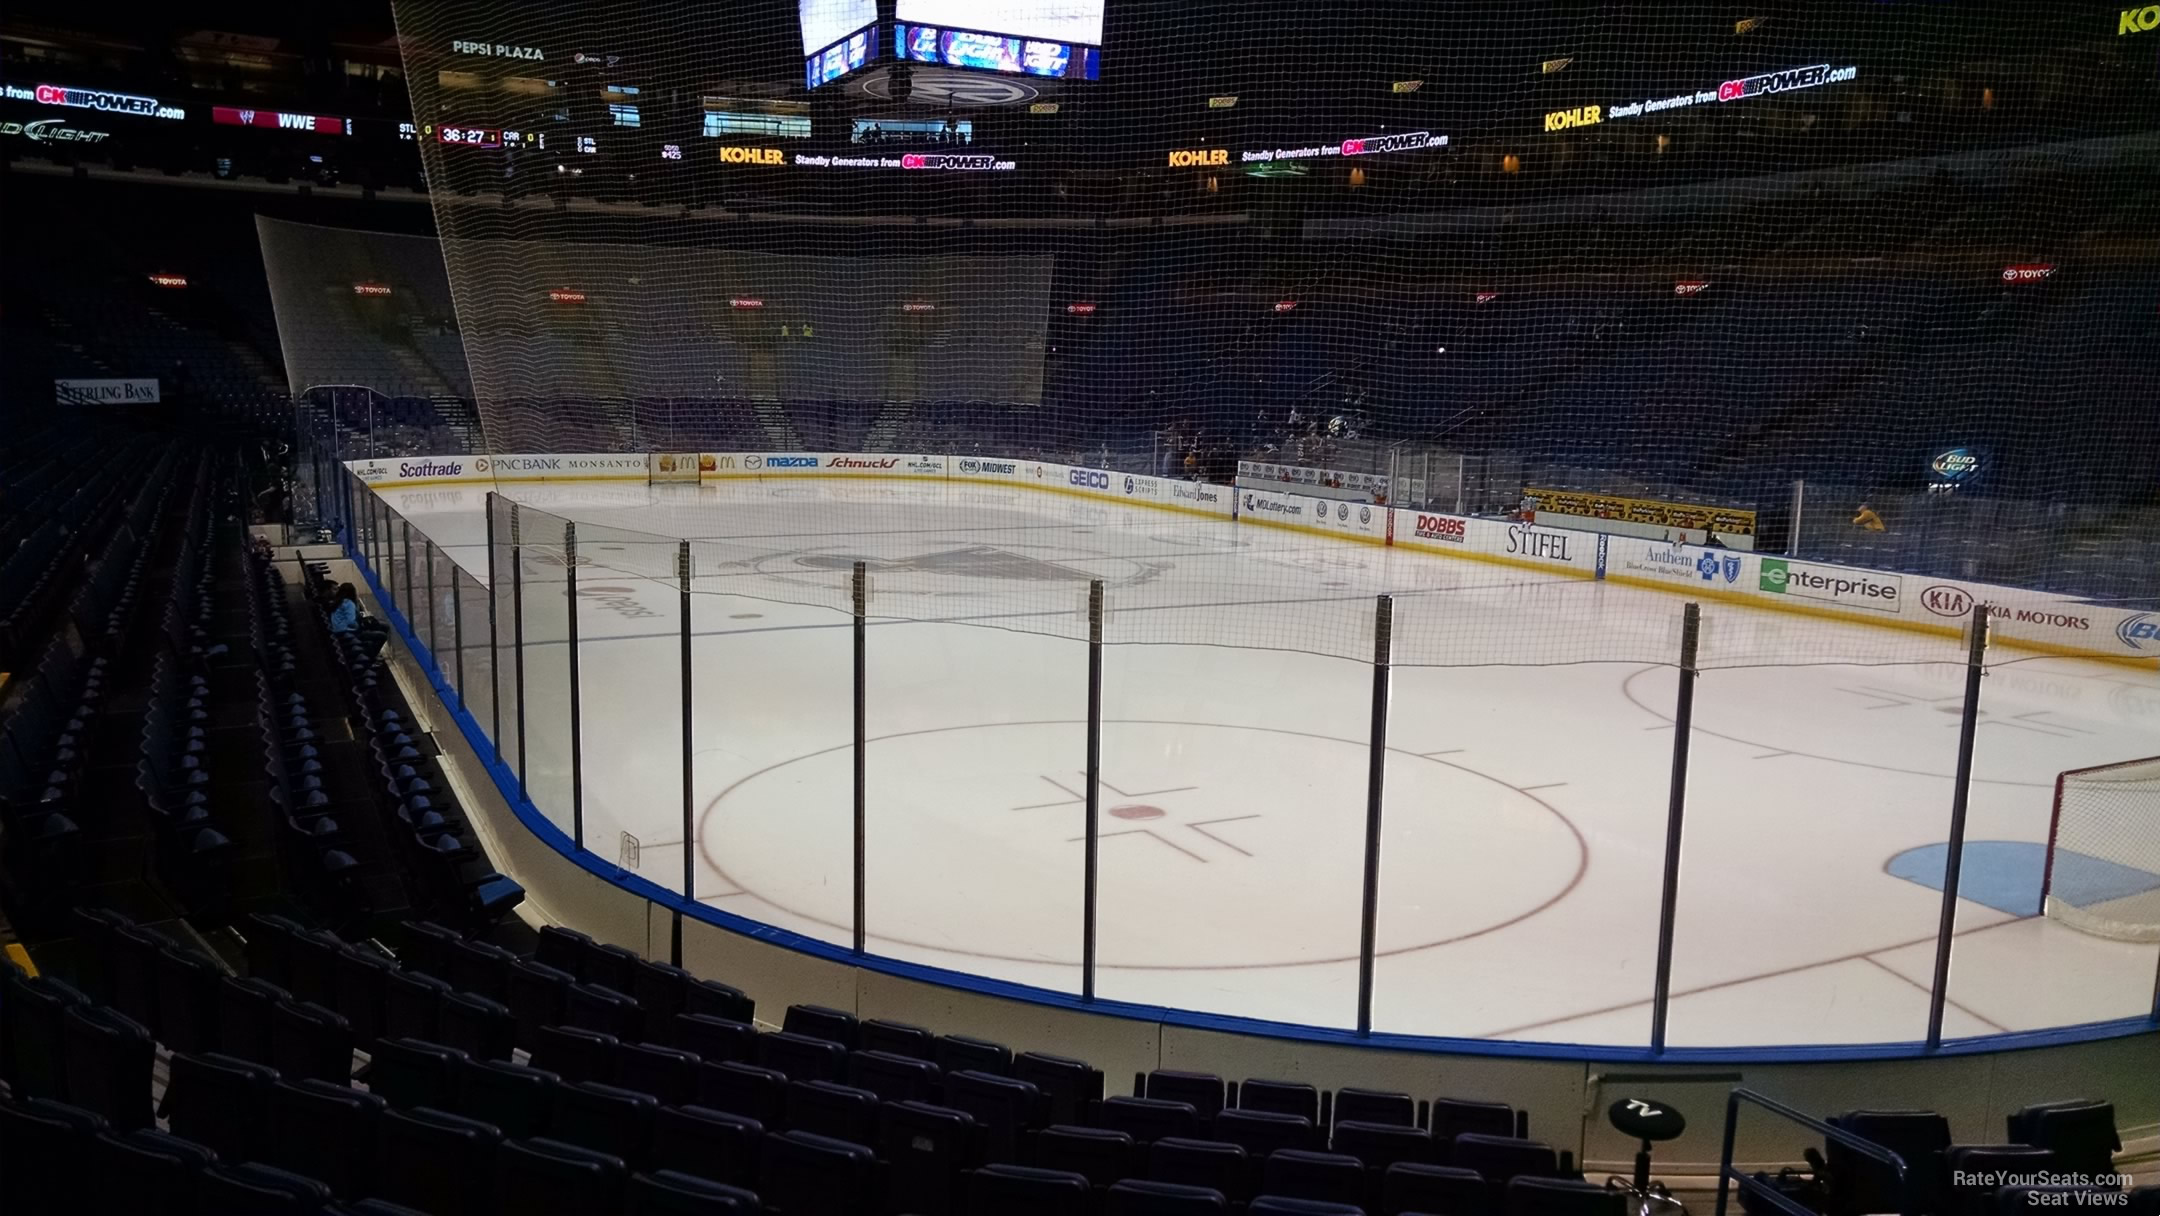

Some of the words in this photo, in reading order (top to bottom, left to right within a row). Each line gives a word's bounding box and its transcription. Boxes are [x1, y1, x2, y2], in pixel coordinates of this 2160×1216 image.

[453, 40, 491, 56] PEPSI
[496, 45, 544, 60] PLAZA
[6, 86, 35, 100] from
[1544, 105, 1601, 132] KOHLER
[1609, 101, 1644, 119] Standby
[1644, 94, 1693, 112] Generators
[1694, 90, 1717, 103] from
[278, 113, 316, 130] WWE
[399, 123, 417, 134] STL
[424, 125, 432, 134] 0
[37, 124, 110, 143] LIGHT
[443, 128, 484, 143] 36:27
[503, 131, 520, 141] CAR
[528, 133, 535, 142] 0
[719, 147, 785, 165] KOHLER
[795, 154, 830, 168] Standby
[831, 155, 880, 168] Generators
[880, 156, 901, 168] from
[1168, 150, 1230, 167] KOHLER
[1242, 149, 1275, 162] Standby
[1275, 147, 1320, 160] Generators
[1320, 145, 1341, 156] from
[60, 381, 121, 401] STERLING
[124, 383, 155, 399] BANK
[568, 459, 641, 469] MONSANTO
[766, 457, 819, 468] mazda
[826, 457, 900, 469] Schnucks
[963, 461, 977, 469] FOX
[981, 462, 1016, 475] MIDWEST
[1940, 462, 1979, 472] LIGHT
[1946, 455, 1976, 464] BUD
[399, 461, 462, 478] Scottrade
[1069, 469, 1109, 490] GEICO
[1134, 478, 1158, 488] EXPRESS
[1134, 486, 1158, 496] SCRIPTS
[1416, 514, 1466, 536] DOBBS
[1507, 525, 1572, 561] STIFEL
[1597, 534, 1608, 569] Reebok
[1645, 546, 1693, 568] Anthem
[1626, 561, 1657, 573] BlueCross
[1658, 565, 1693, 578] BlueShield
[1763, 567, 1897, 600] enterprise
[1929, 590, 1965, 613] KIA
[2016, 610, 2090, 630] MOTORS
[1626, 1098, 1663, 1117] TV
